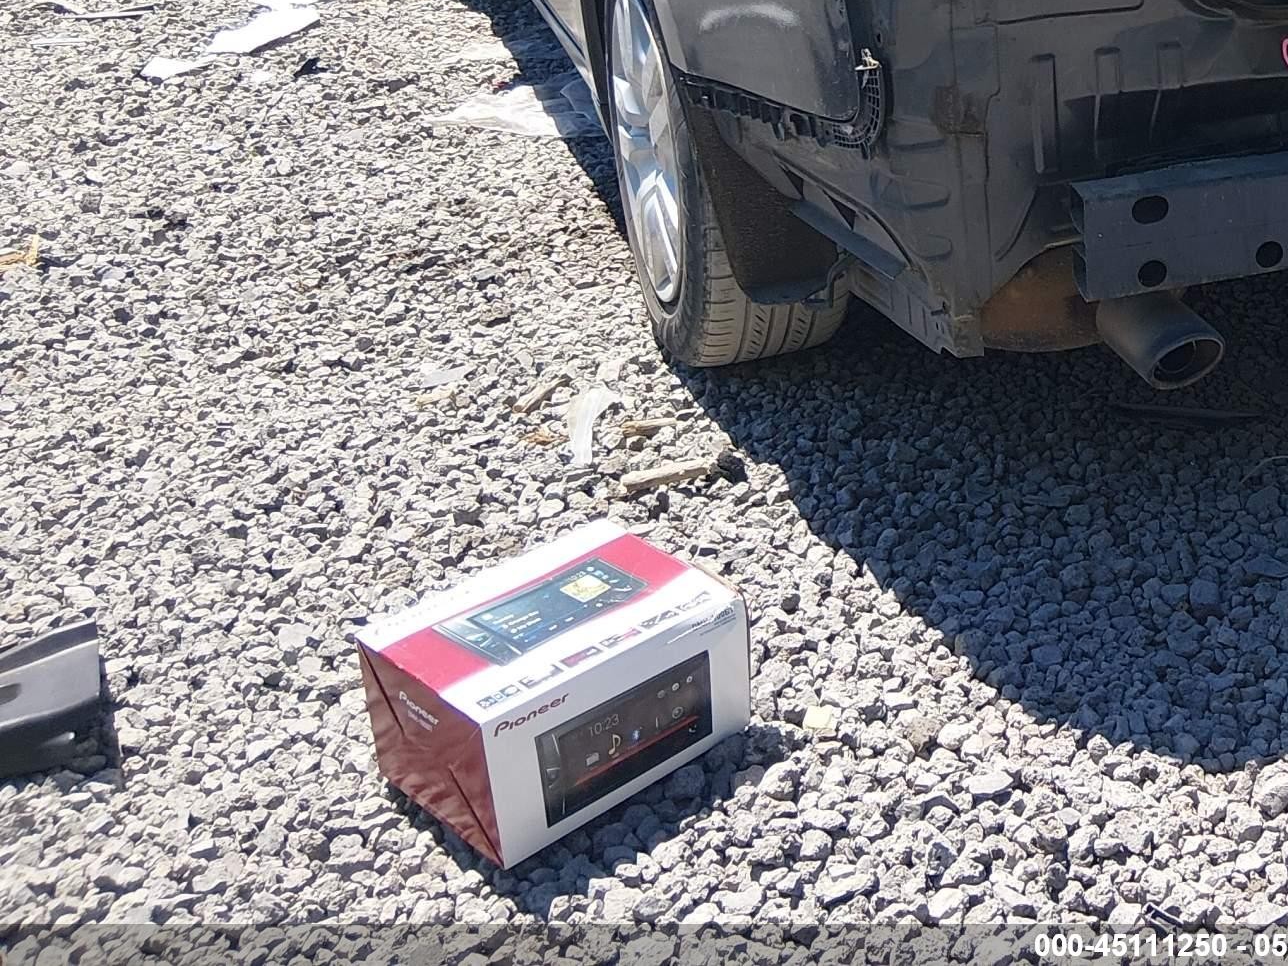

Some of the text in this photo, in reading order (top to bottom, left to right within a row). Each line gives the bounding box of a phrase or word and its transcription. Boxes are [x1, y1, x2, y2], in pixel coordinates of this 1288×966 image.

[398, 690, 440, 726] Pioneer
[493, 693, 569, 737] Pioneer
[589, 713, 620, 737] 10:23
